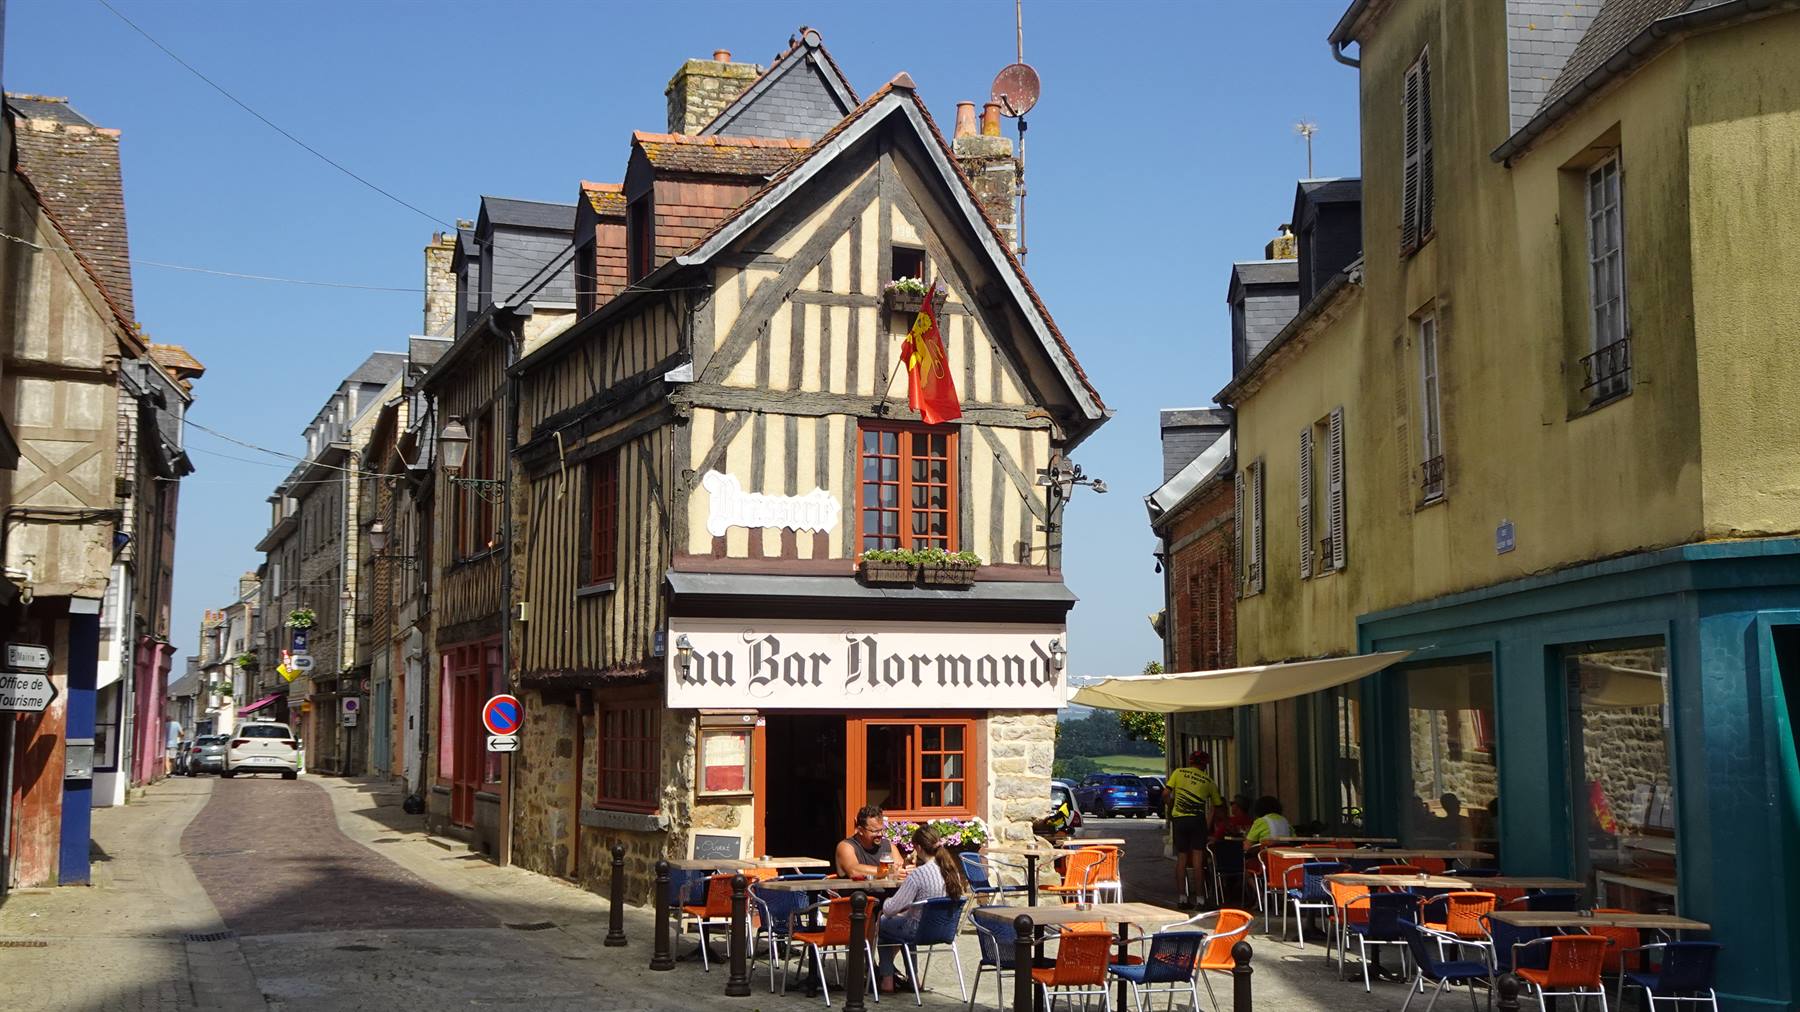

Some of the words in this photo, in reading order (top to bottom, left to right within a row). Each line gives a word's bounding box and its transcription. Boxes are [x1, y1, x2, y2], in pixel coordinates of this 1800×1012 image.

[0, 676, 28, 690] Office
[31, 679, 43, 690] de
[742, 629, 831, 697] Bar
[845, 631, 1050, 694] Normand
